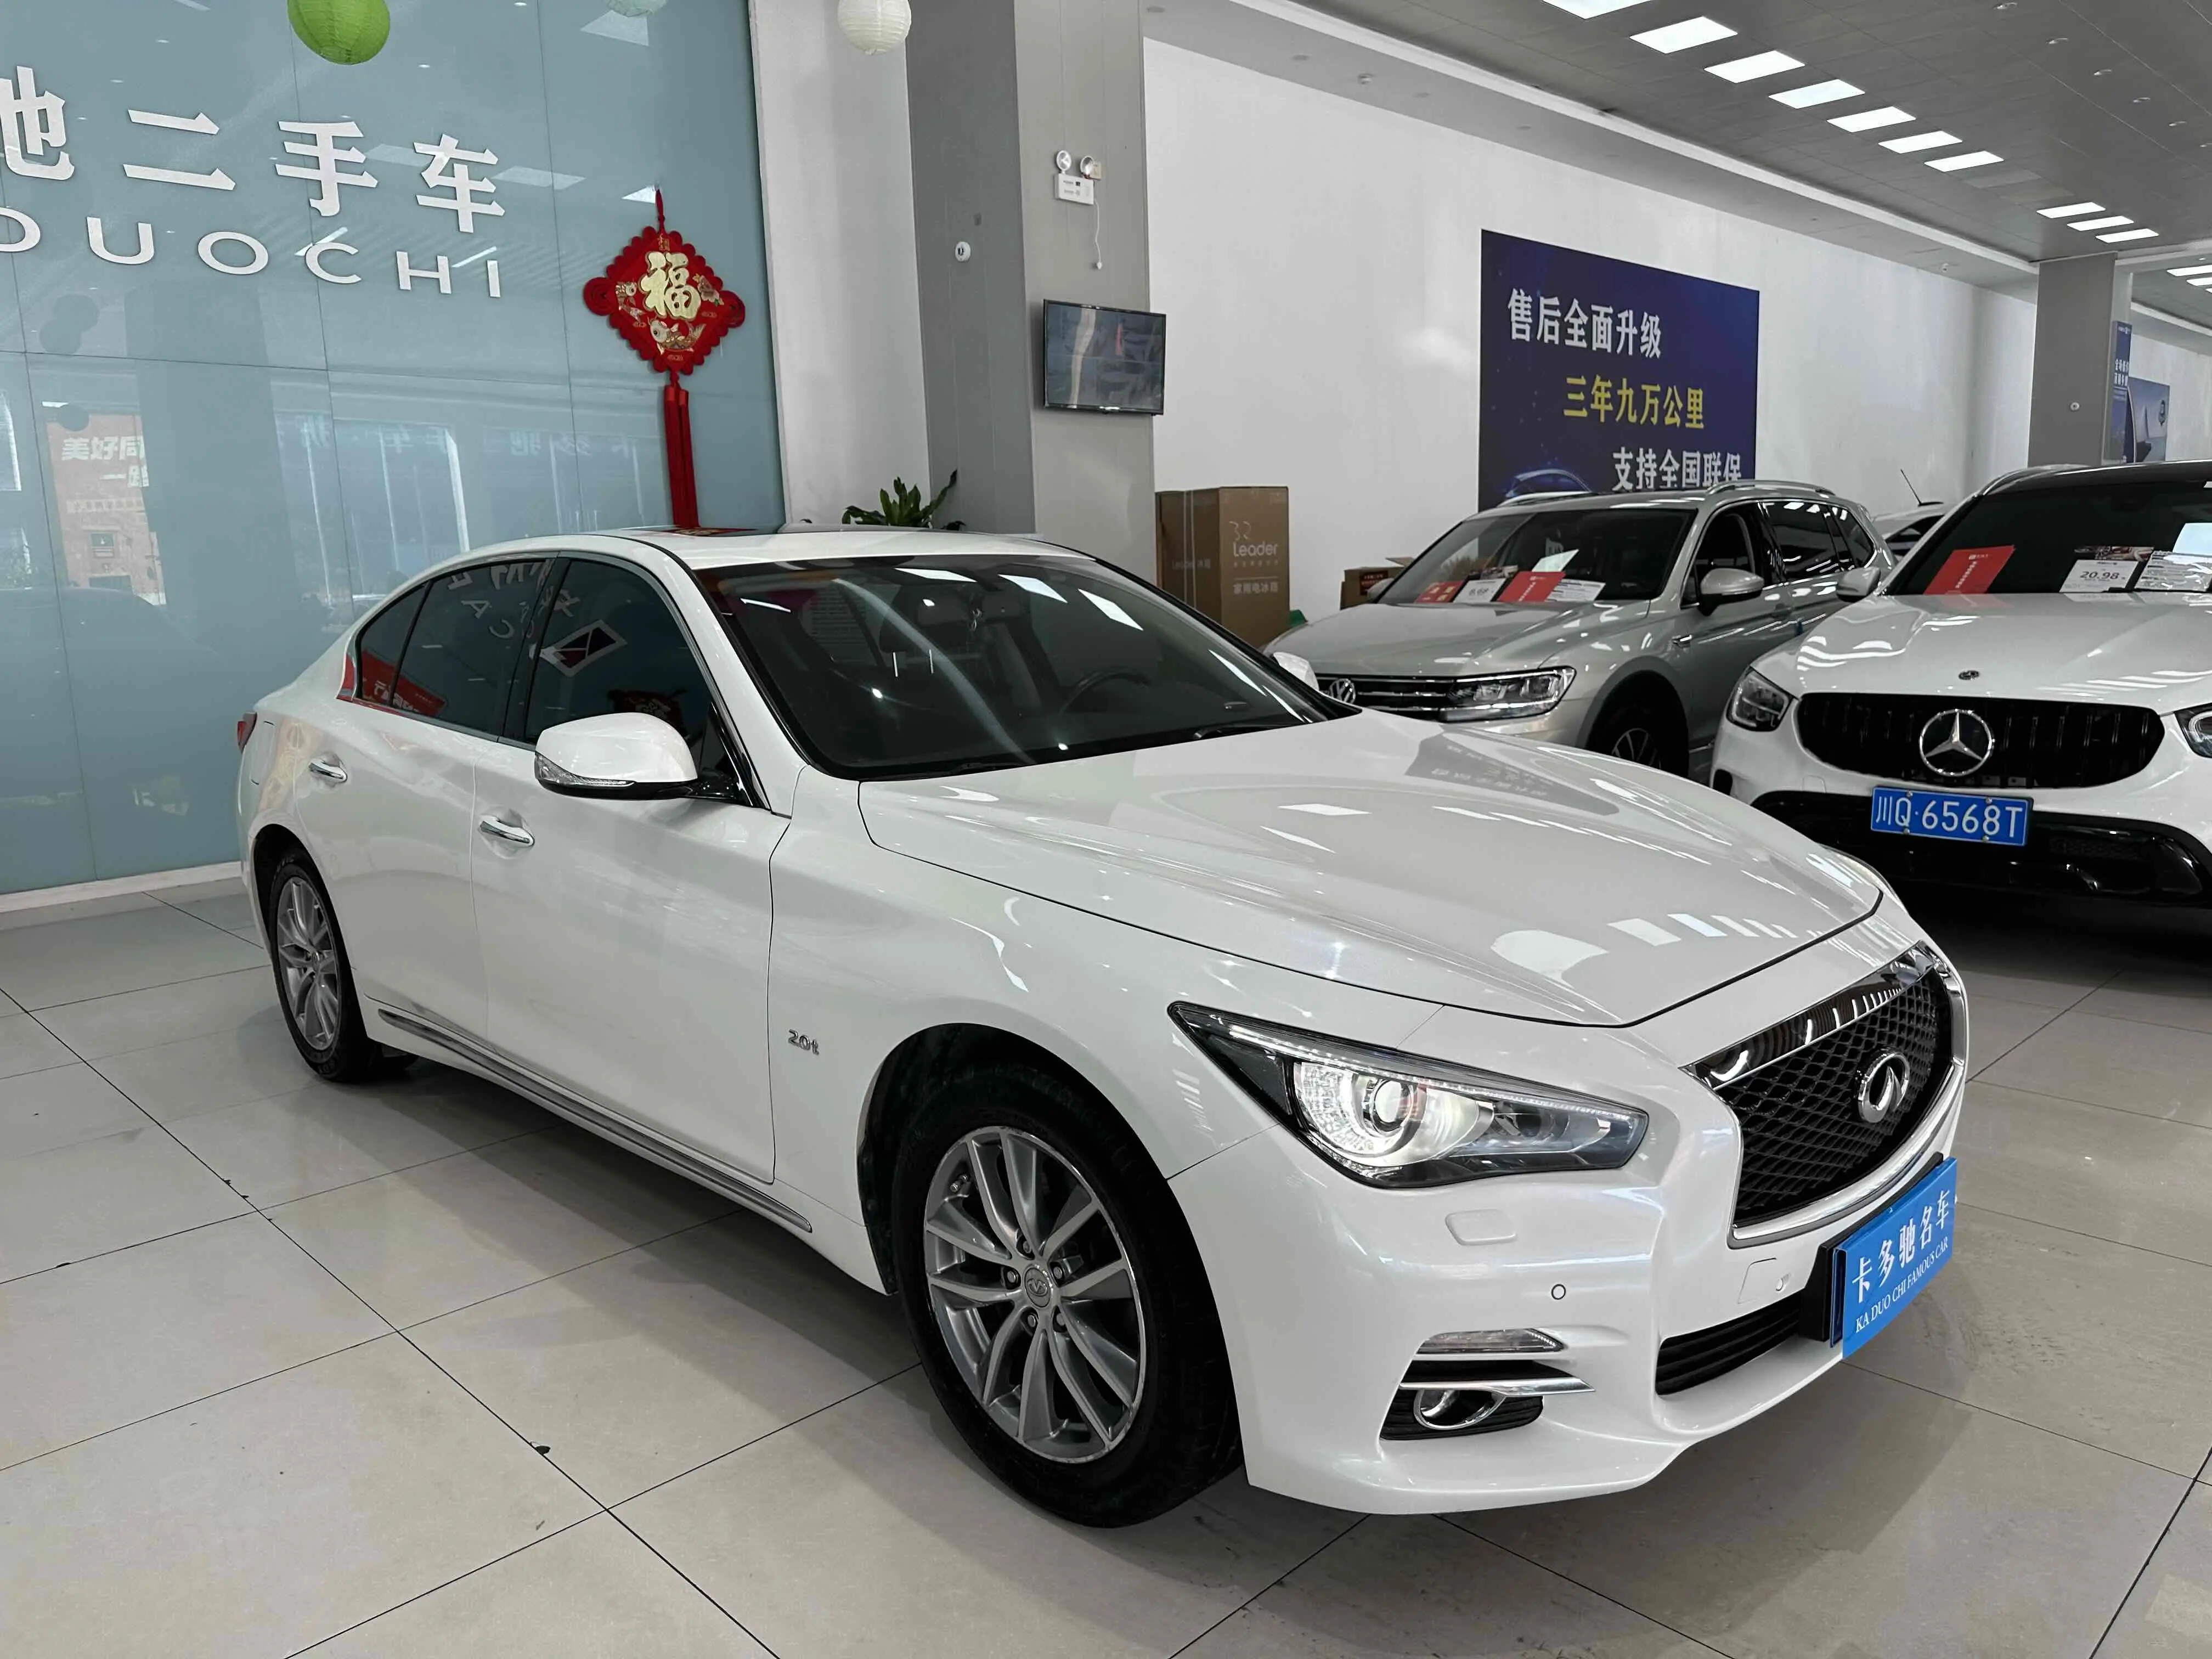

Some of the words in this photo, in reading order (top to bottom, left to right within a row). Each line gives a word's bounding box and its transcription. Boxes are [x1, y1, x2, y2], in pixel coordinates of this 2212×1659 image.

[640, 252, 701, 318] 福
[1508, 288, 1661, 358] 售后全面升级
[1564, 374, 1704, 429] 三年九万公里
[1612, 447, 1741, 491] 支持全国联保
[1233, 540, 1278, 557] Leader
[2080, 571, 2120, 579] 20.98
[1852, 1189, 1950, 1304] 卡多驰名车
[1856, 1312, 1870, 1333] KA
[1871, 1294, 1891, 1320] DUO
[1892, 1278, 1907, 1302] CHI
[1907, 1253, 1935, 1289] FAMOUS
[1935, 1236, 1949, 1261] CAR
